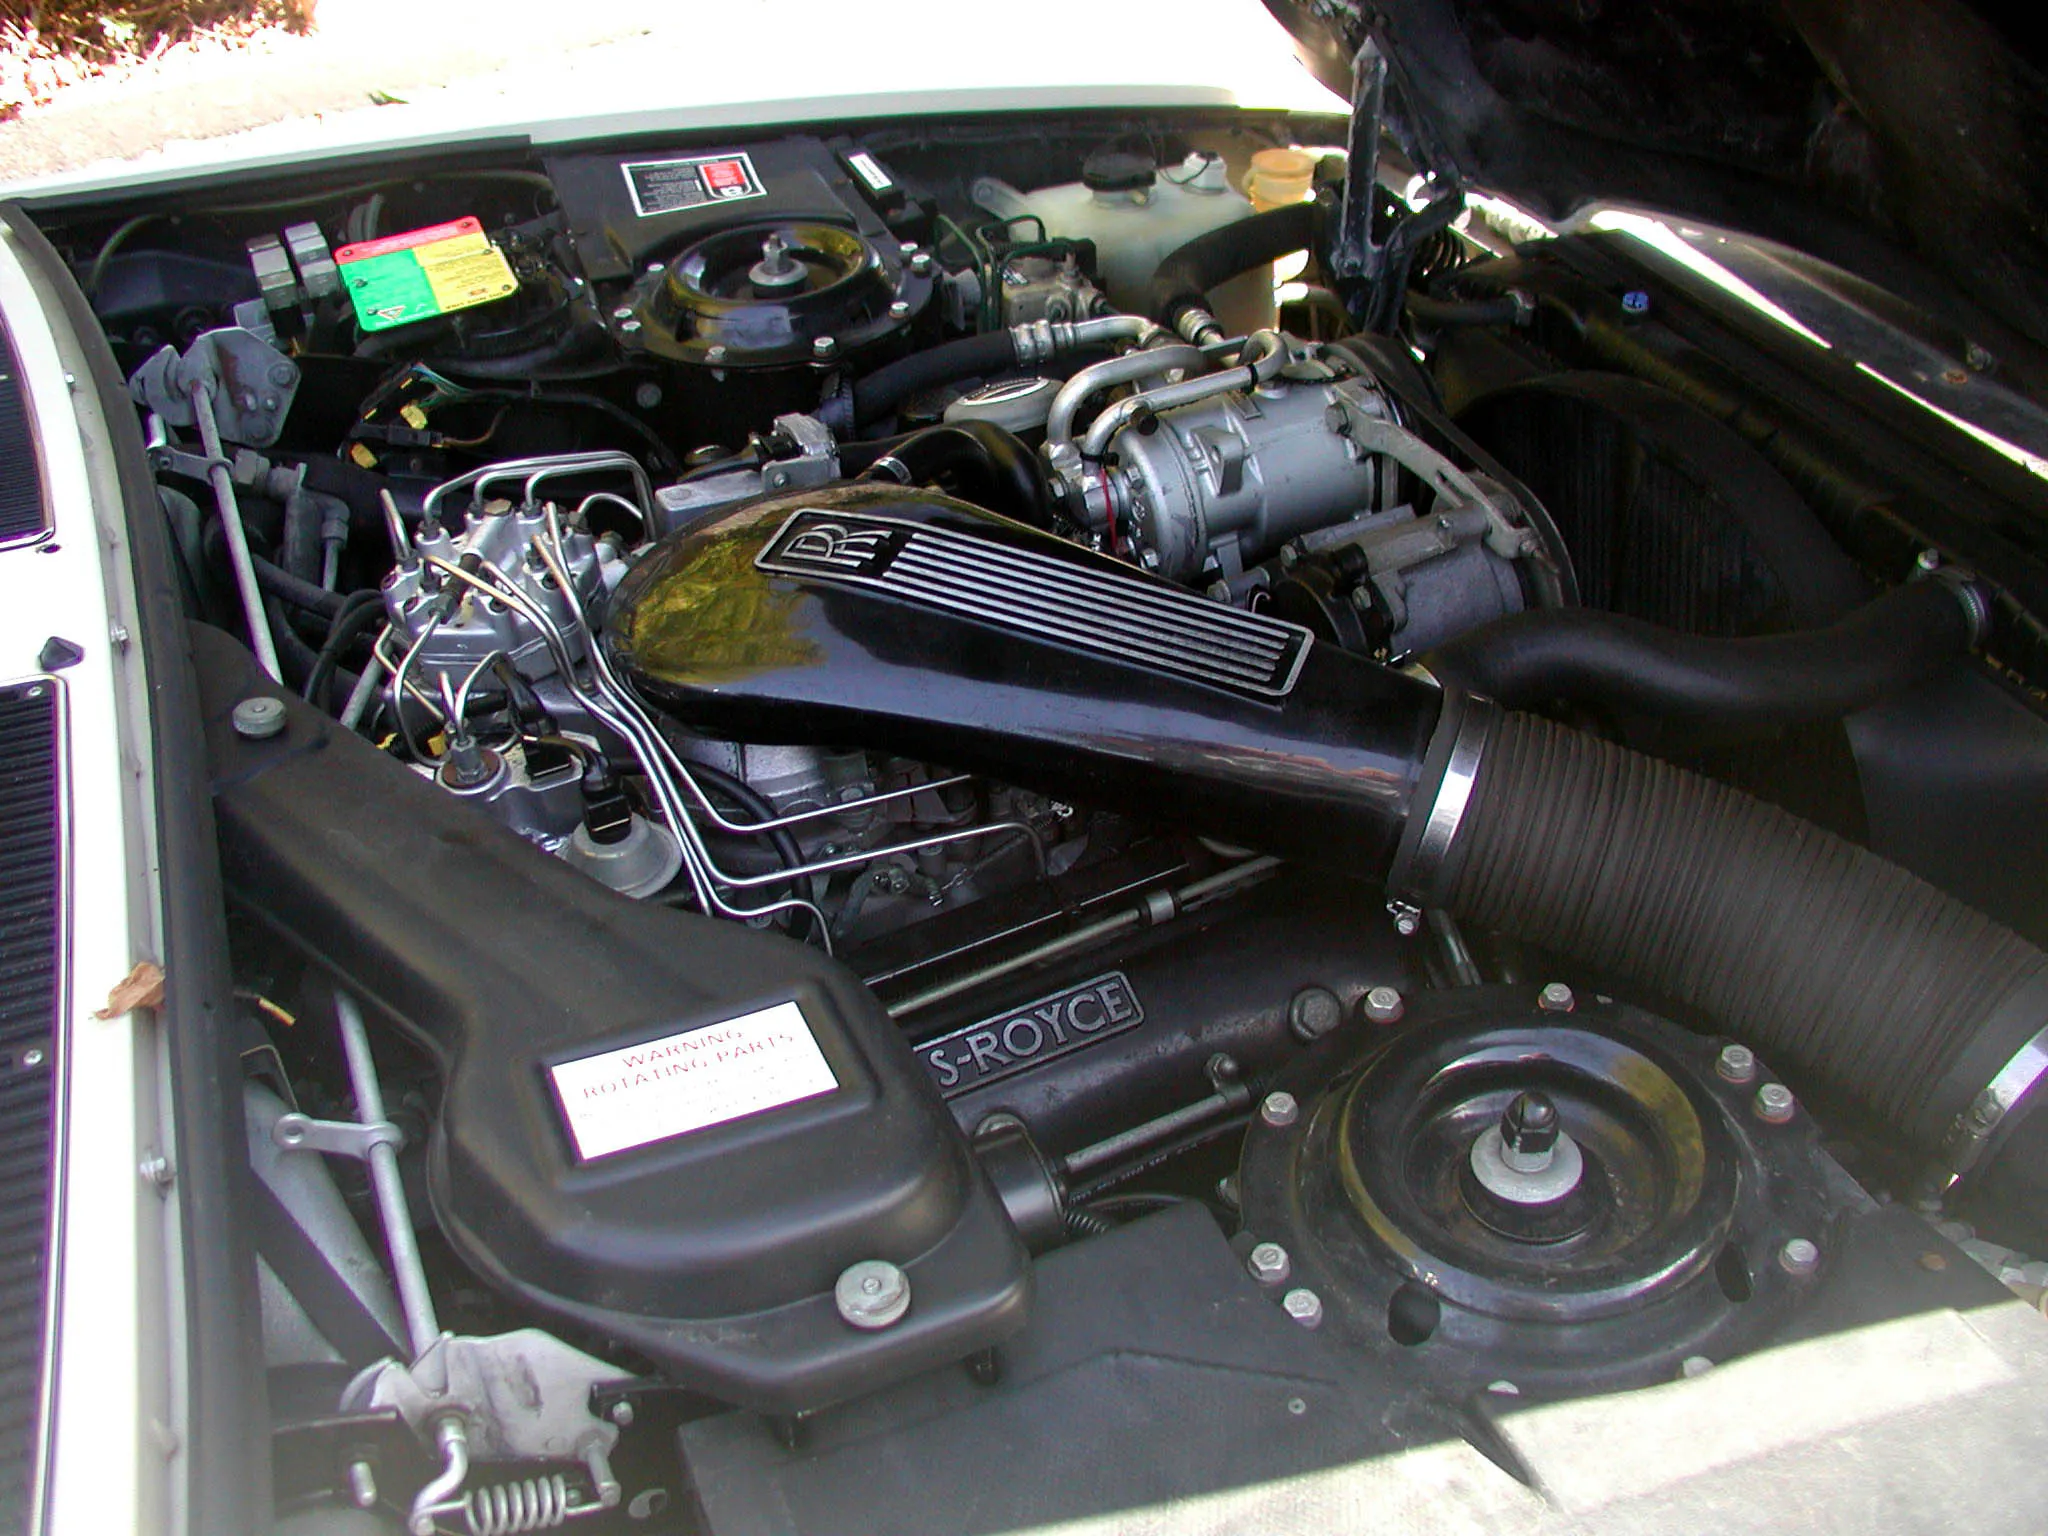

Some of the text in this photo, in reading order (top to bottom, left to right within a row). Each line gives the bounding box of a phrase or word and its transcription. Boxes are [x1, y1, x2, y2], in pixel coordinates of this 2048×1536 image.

[583, 1059, 708, 1099] ROTATING
[716, 1032, 794, 1063] PARTS
[622, 1028, 745, 1068] WARNING
